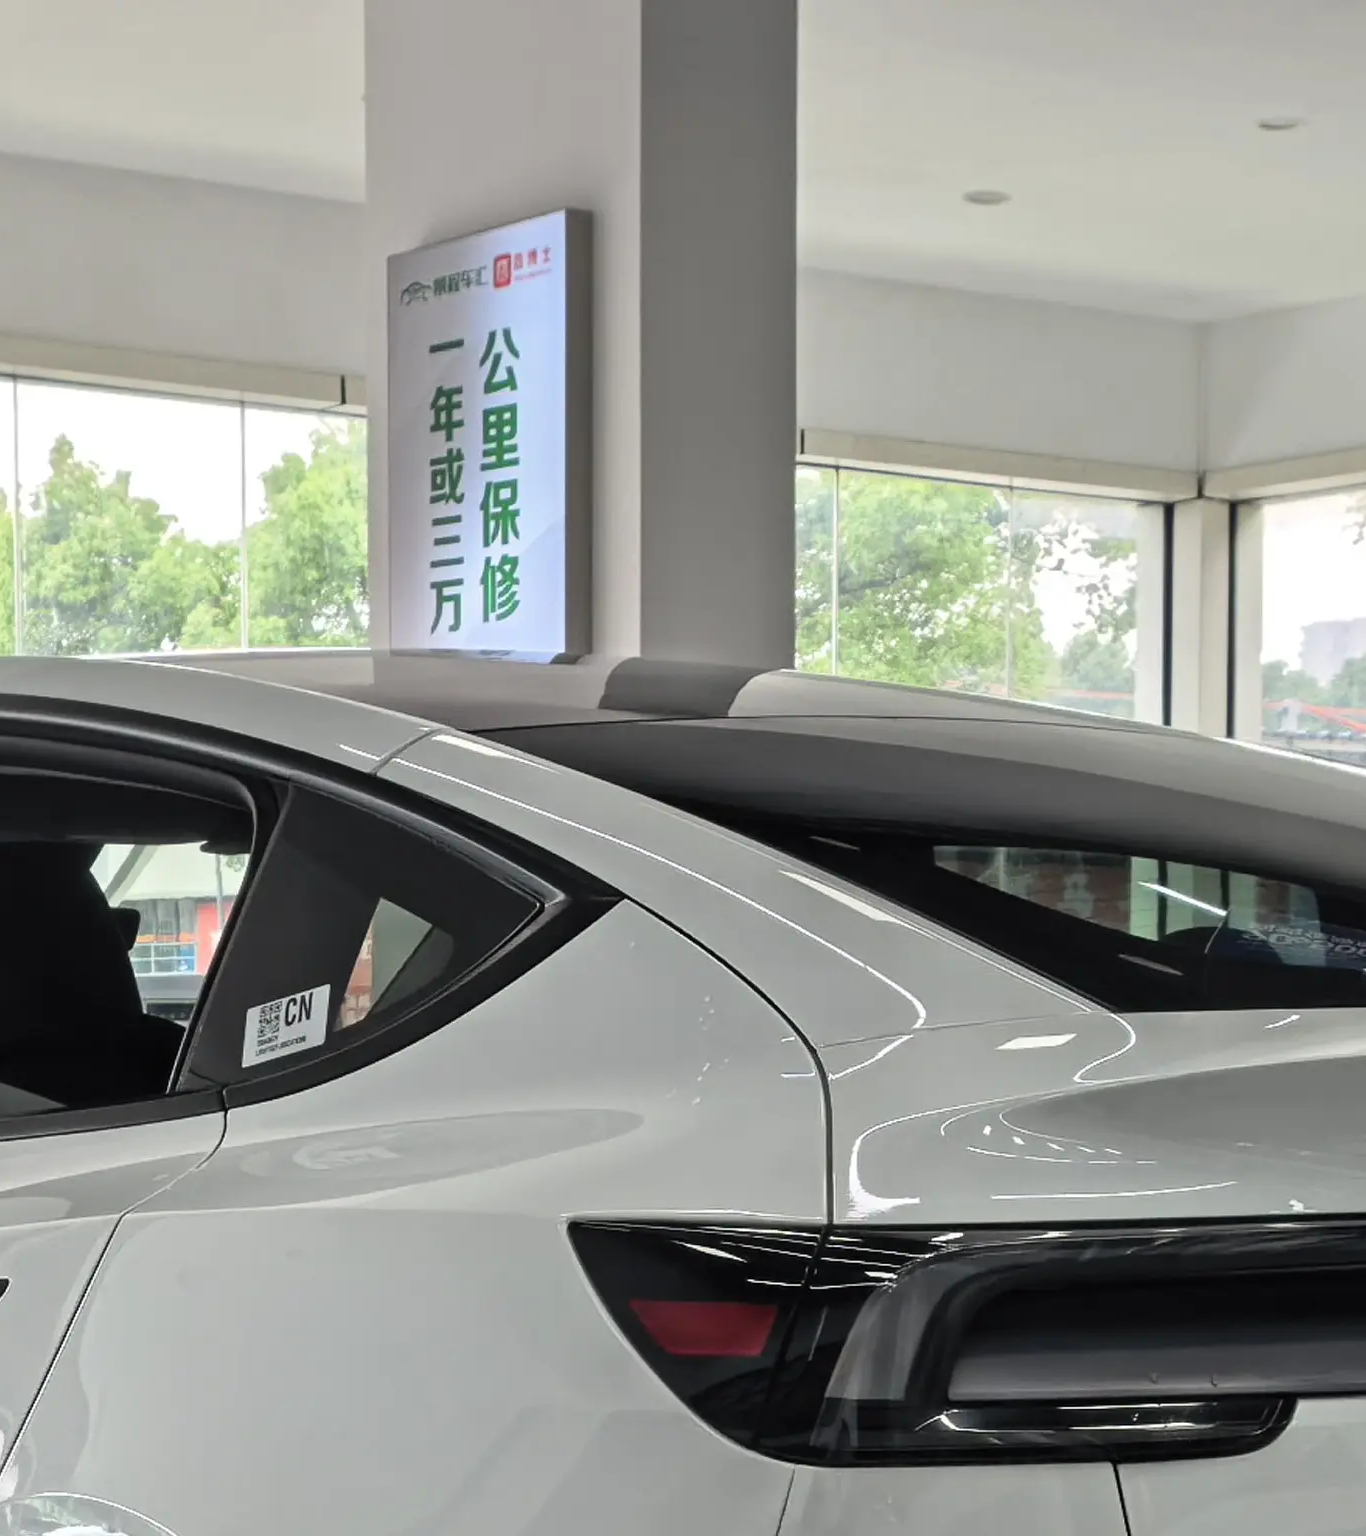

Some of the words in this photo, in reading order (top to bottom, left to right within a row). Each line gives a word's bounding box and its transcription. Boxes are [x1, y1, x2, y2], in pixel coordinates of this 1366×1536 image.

[429, 337, 465, 636] 一年或三万
[479, 326, 521, 626] 公里保修
[285, 992, 313, 1027] CN
